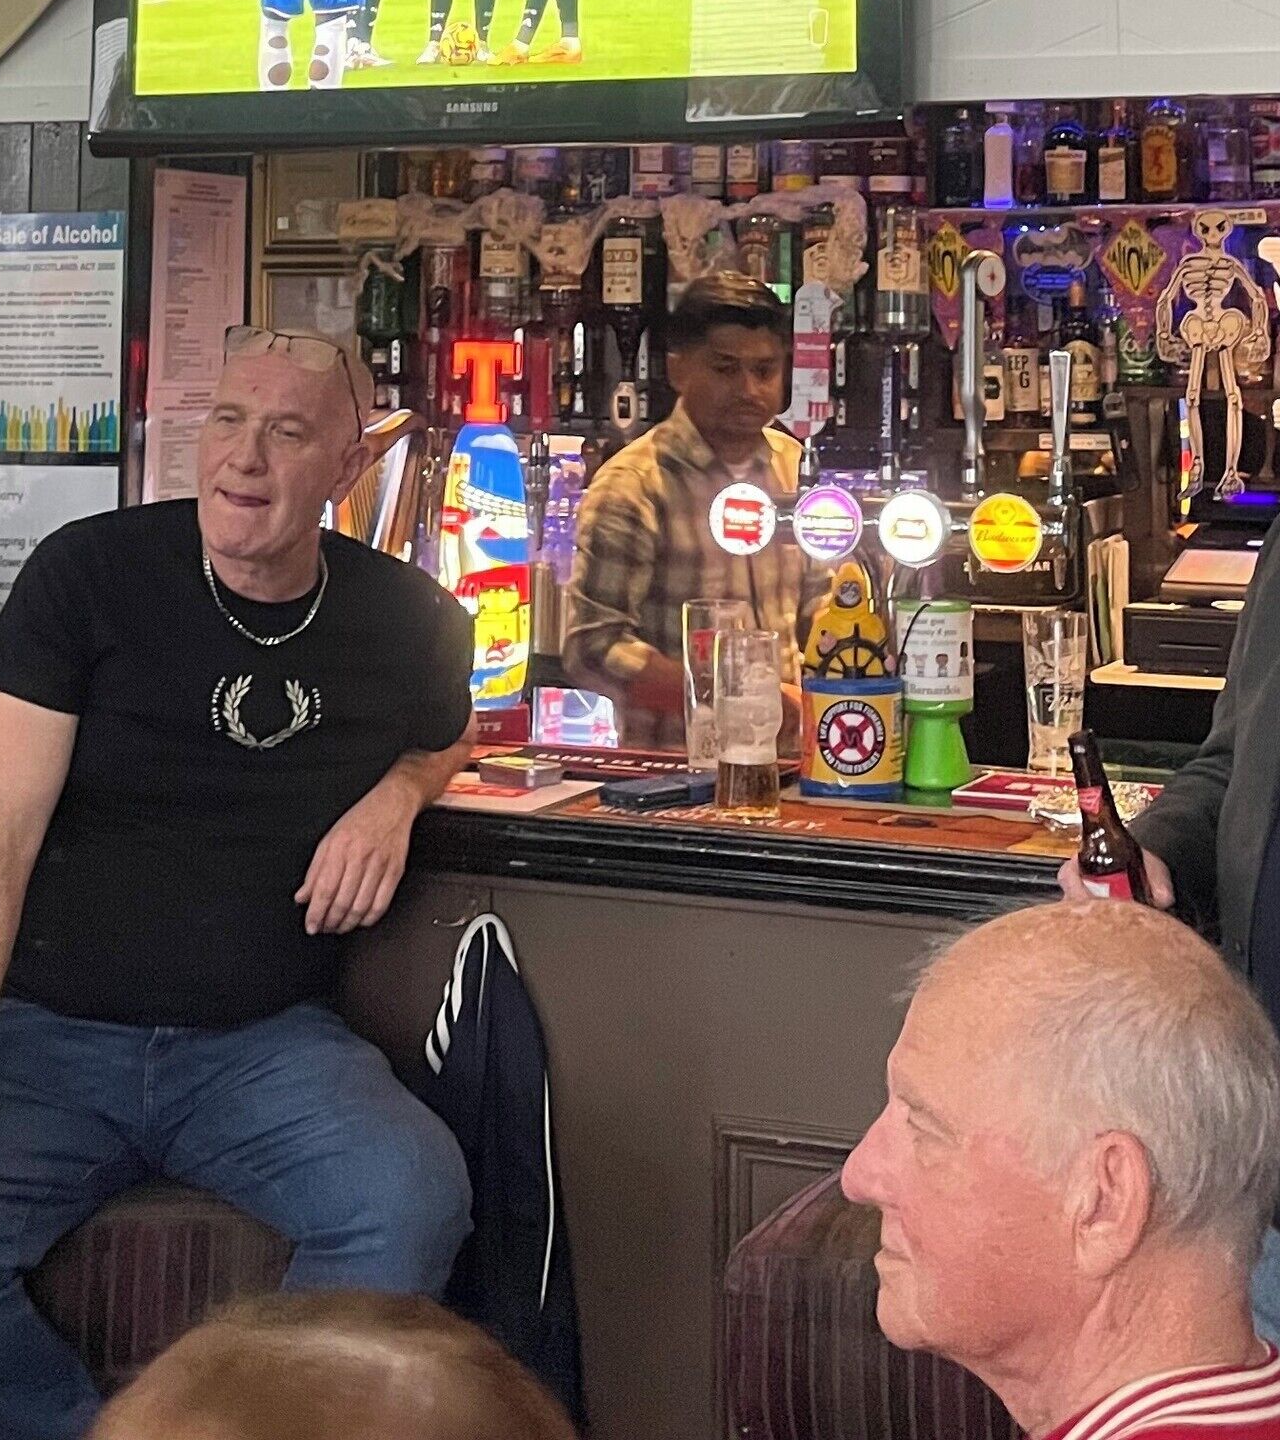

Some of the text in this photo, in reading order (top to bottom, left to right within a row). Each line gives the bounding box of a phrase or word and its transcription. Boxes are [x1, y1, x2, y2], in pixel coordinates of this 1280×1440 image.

[446, 102, 498, 113] SAMSUNG
[32, 225, 48, 244] of
[52, 223, 118, 244] Alcohol
[452, 339, 524, 424] T
[975, 528, 1037, 544] Budweiser
